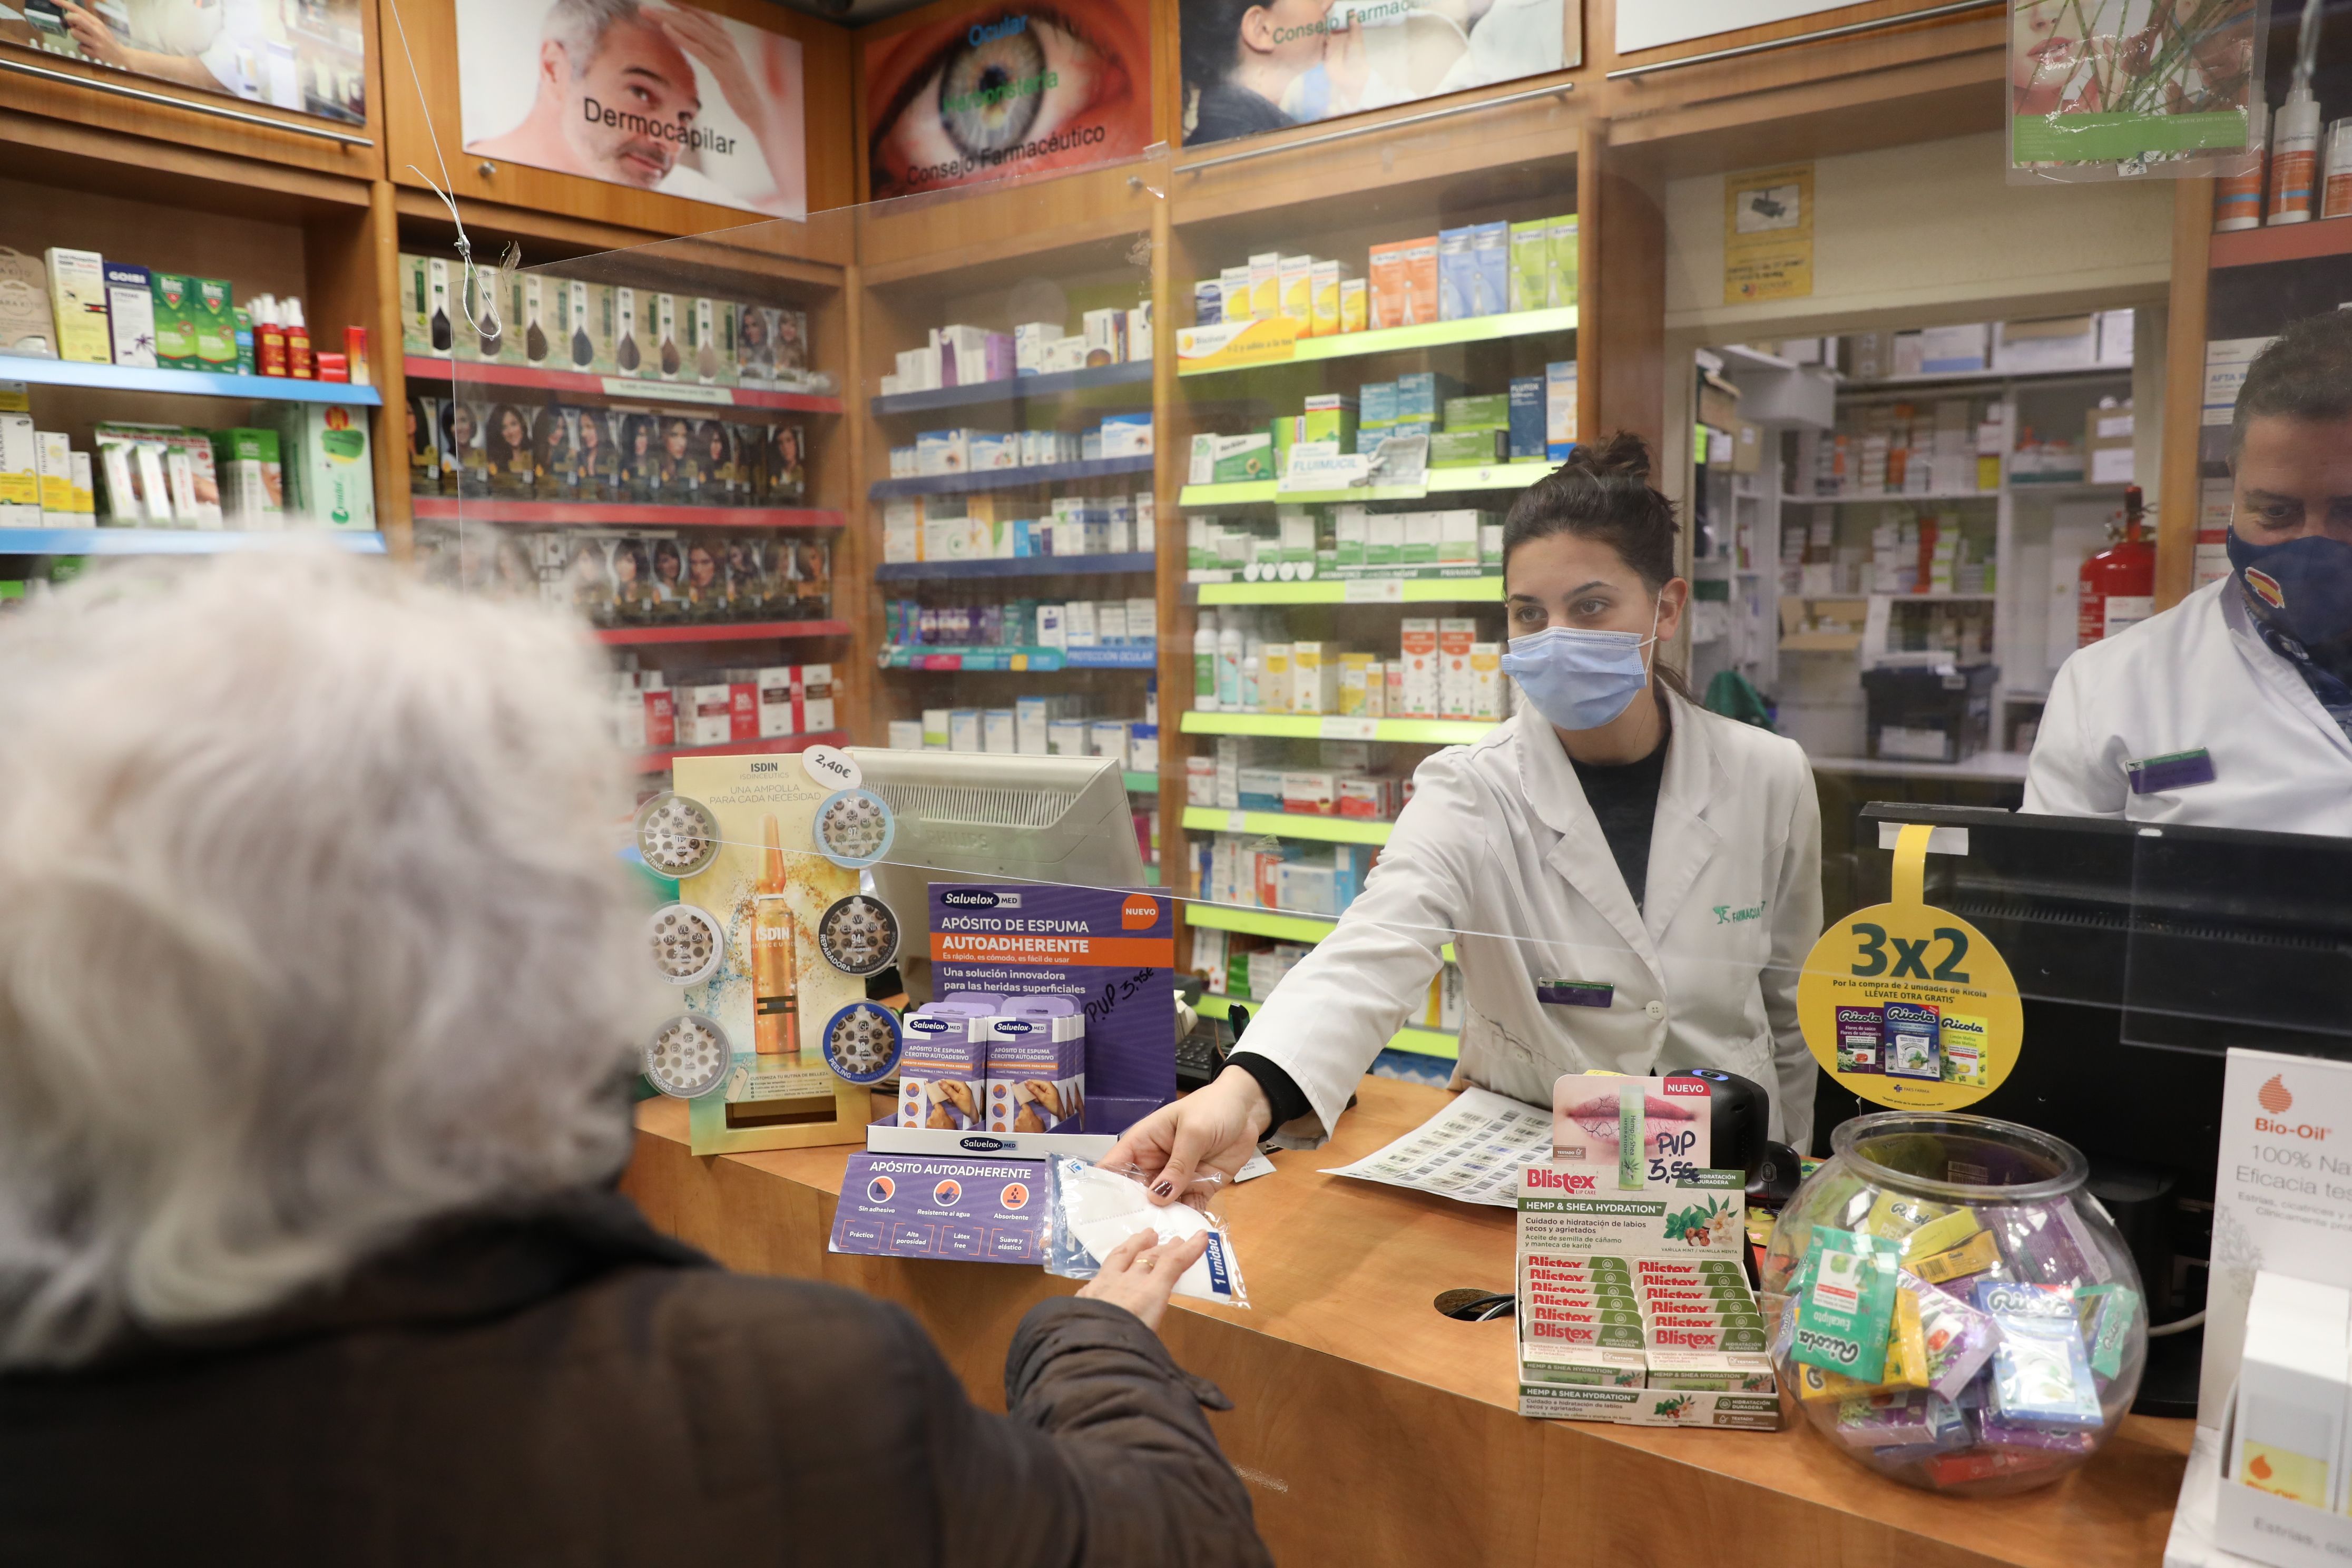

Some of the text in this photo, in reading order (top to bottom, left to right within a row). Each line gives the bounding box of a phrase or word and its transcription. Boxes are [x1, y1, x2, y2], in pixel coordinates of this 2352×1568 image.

[968, 15, 1029, 46] Ocular
[1273, 16, 1340, 44] Consejo
[584, 97, 736, 154] Dermocapilar
[907, 124, 1105, 186] Consejo Farmacéutico
[751, 762, 778, 772] ISDIN
[815, 754, 851, 778] 2,40€
[754, 784, 800, 793] AMPOLLA
[767, 792, 821, 802] NECESIDAD
[642, 850, 664, 870] LIFTING
[946, 894, 993, 905] Salvelox
[942, 916, 1089, 932] APÓSITO DE ESPUMA
[756, 926, 789, 942] ISDIN
[820, 934, 850, 972] REPARADORA
[943, 936, 1089, 953] AUTOADHERENTE
[987, 954, 1016, 963] cómodo,
[1851, 923, 1969, 984] 3x2
[944, 968, 1065, 980] Una solución innovadora
[944, 983, 965, 992] para
[984, 983, 1020, 992] heridas
[1023, 984, 1085, 994] superficiales
[1859, 982, 1889, 990] compra
[1911, 984, 1947, 992] unidades
[1963, 988, 1986, 997] Ricola
[1839, 1011, 1881, 1023] Ricola
[1888, 1007, 1934, 1022] Ricola
[913, 1021, 944, 1030] Salvelox
[1941, 1018, 1983, 1033] Ricola
[647, 1048, 672, 1091] ANTIMANCHAS
[829, 1058, 851, 1079] PEELING
[1668, 1084, 1704, 1093] NUEVO
[2255, 1117, 2326, 1141] Bio-Oil
[1656, 1131, 1696, 1157] P.V.P
[2252, 1144, 2311, 1169] 100%
[869, 1161, 1032, 1179] APÓSITO AUTOADHERENTE
[1527, 1169, 1595, 1194] Blistex
[2236, 1165, 2316, 1194] Eficacia
[1527, 1202, 1555, 1210] HEMP
[1596, 1204, 1655, 1213] HYDRATION
[1566, 1218, 1610, 1227] hidratación
[1814, 1311, 1851, 1331] Eucalipto
